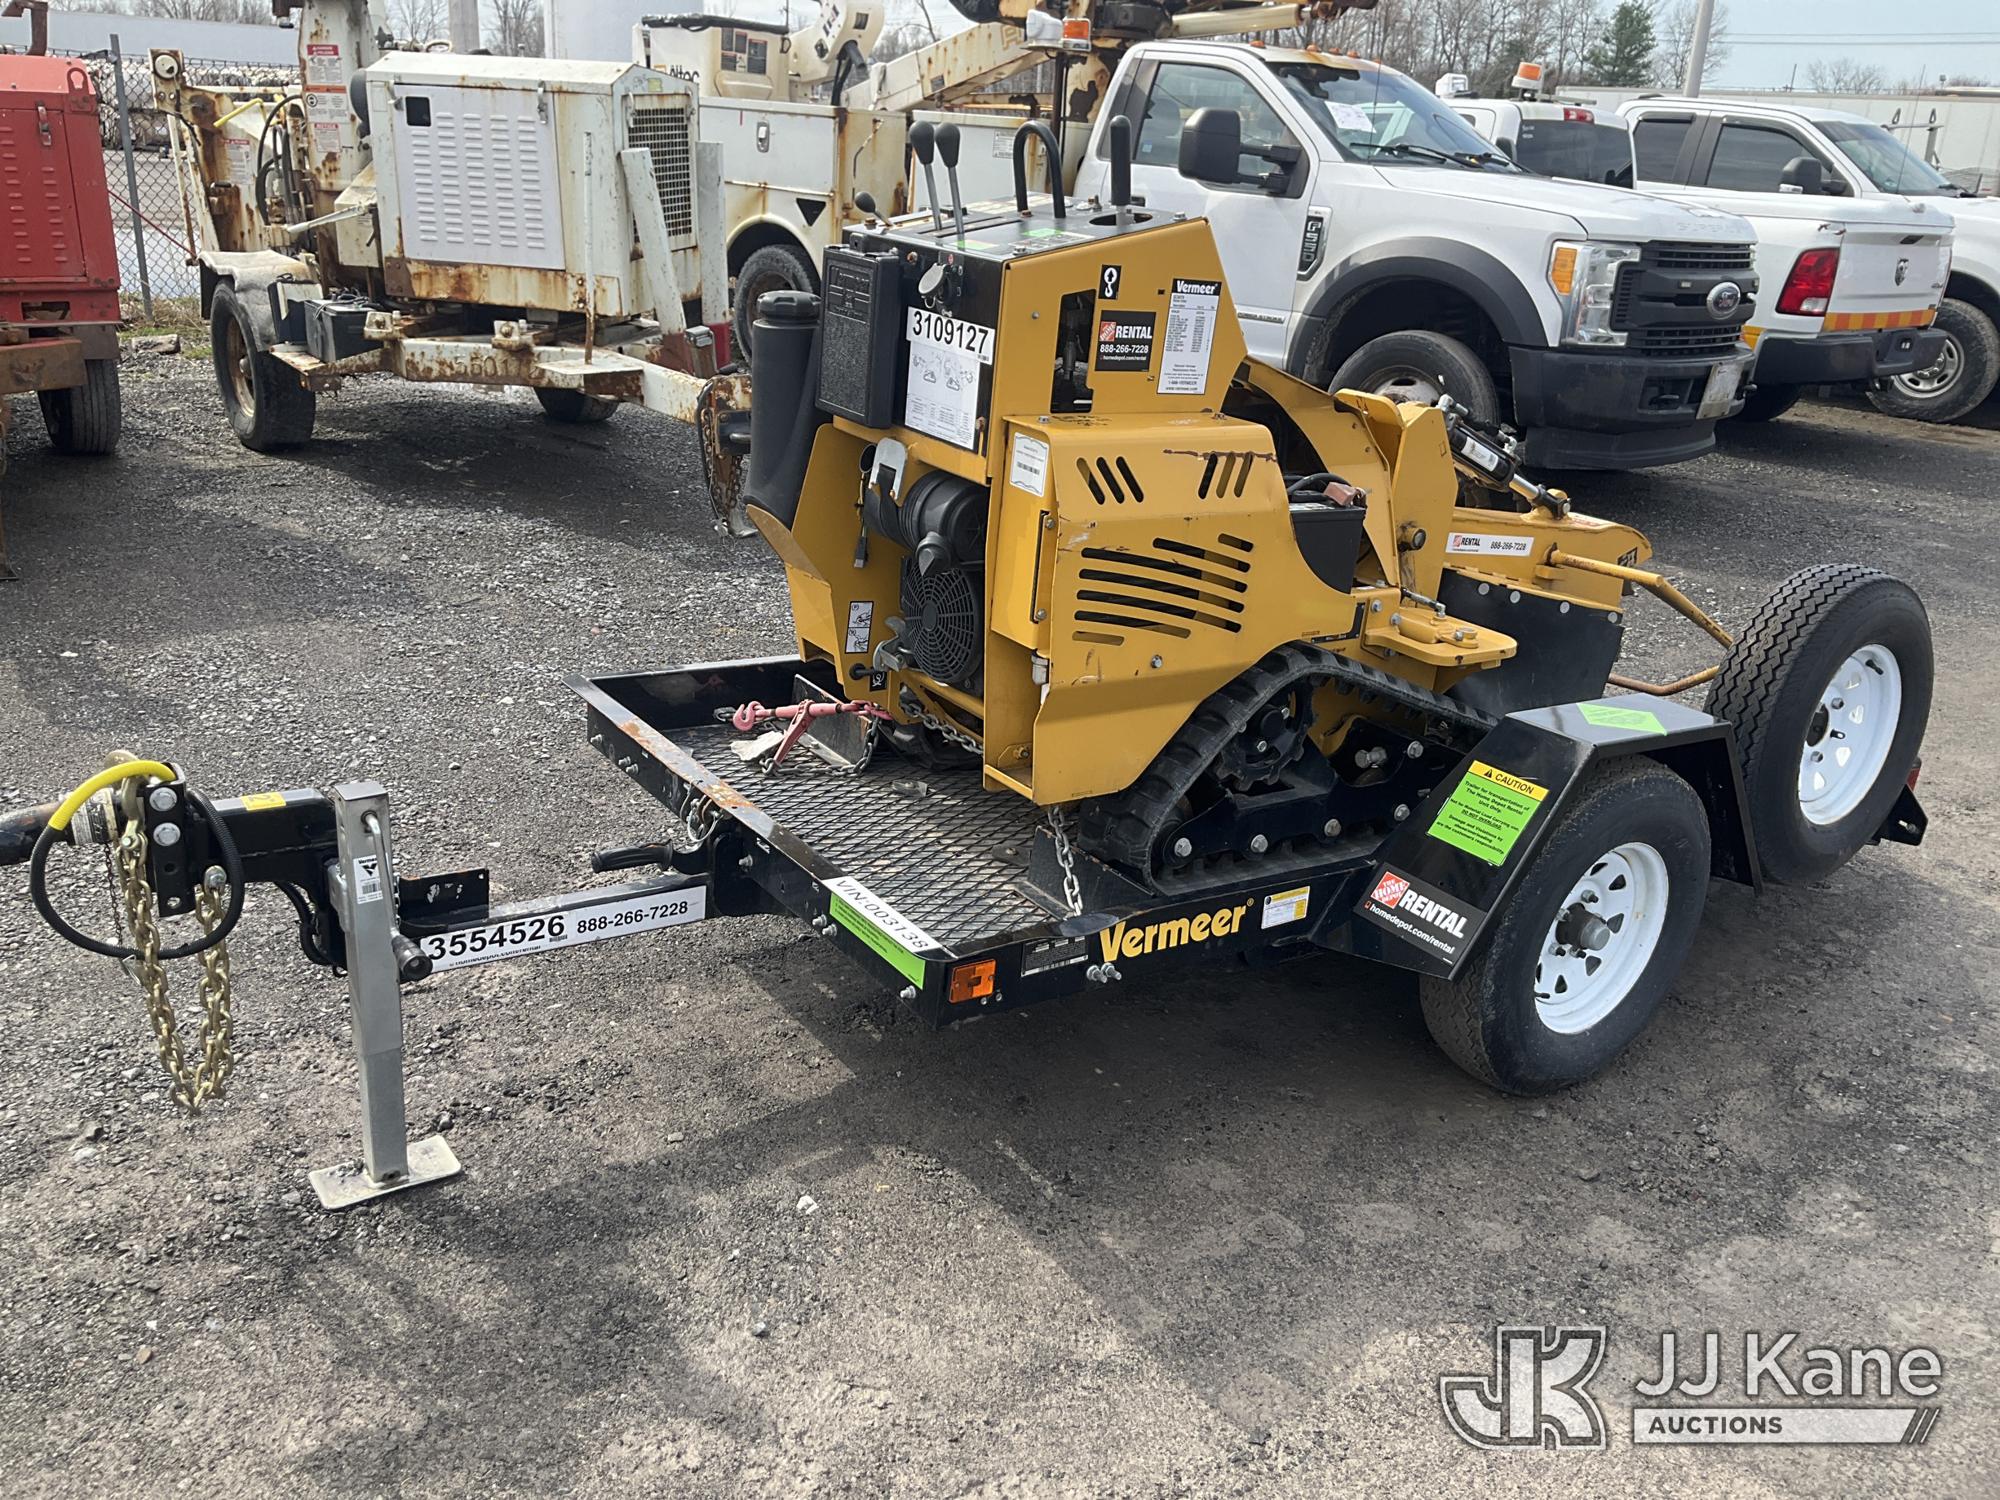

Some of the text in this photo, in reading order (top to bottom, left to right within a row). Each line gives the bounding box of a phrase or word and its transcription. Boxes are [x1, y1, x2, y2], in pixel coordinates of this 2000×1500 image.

[912, 311, 989, 354] 3109127
[1115, 325, 1152, 339] RENTAL
[1100, 344, 1149, 353] 888-266-7228
[1461, 537, 1480, 546] RENTAL
[1495, 773, 1534, 794] CAUTION
[1374, 883, 1406, 898] HOME
[835, 880, 929, 948] VIN:003138
[1369, 903, 1455, 954] homedepot.com/rental
[1399, 889, 1467, 938] RENTAL
[428, 901, 688, 960] 3554526 888-266-7228
